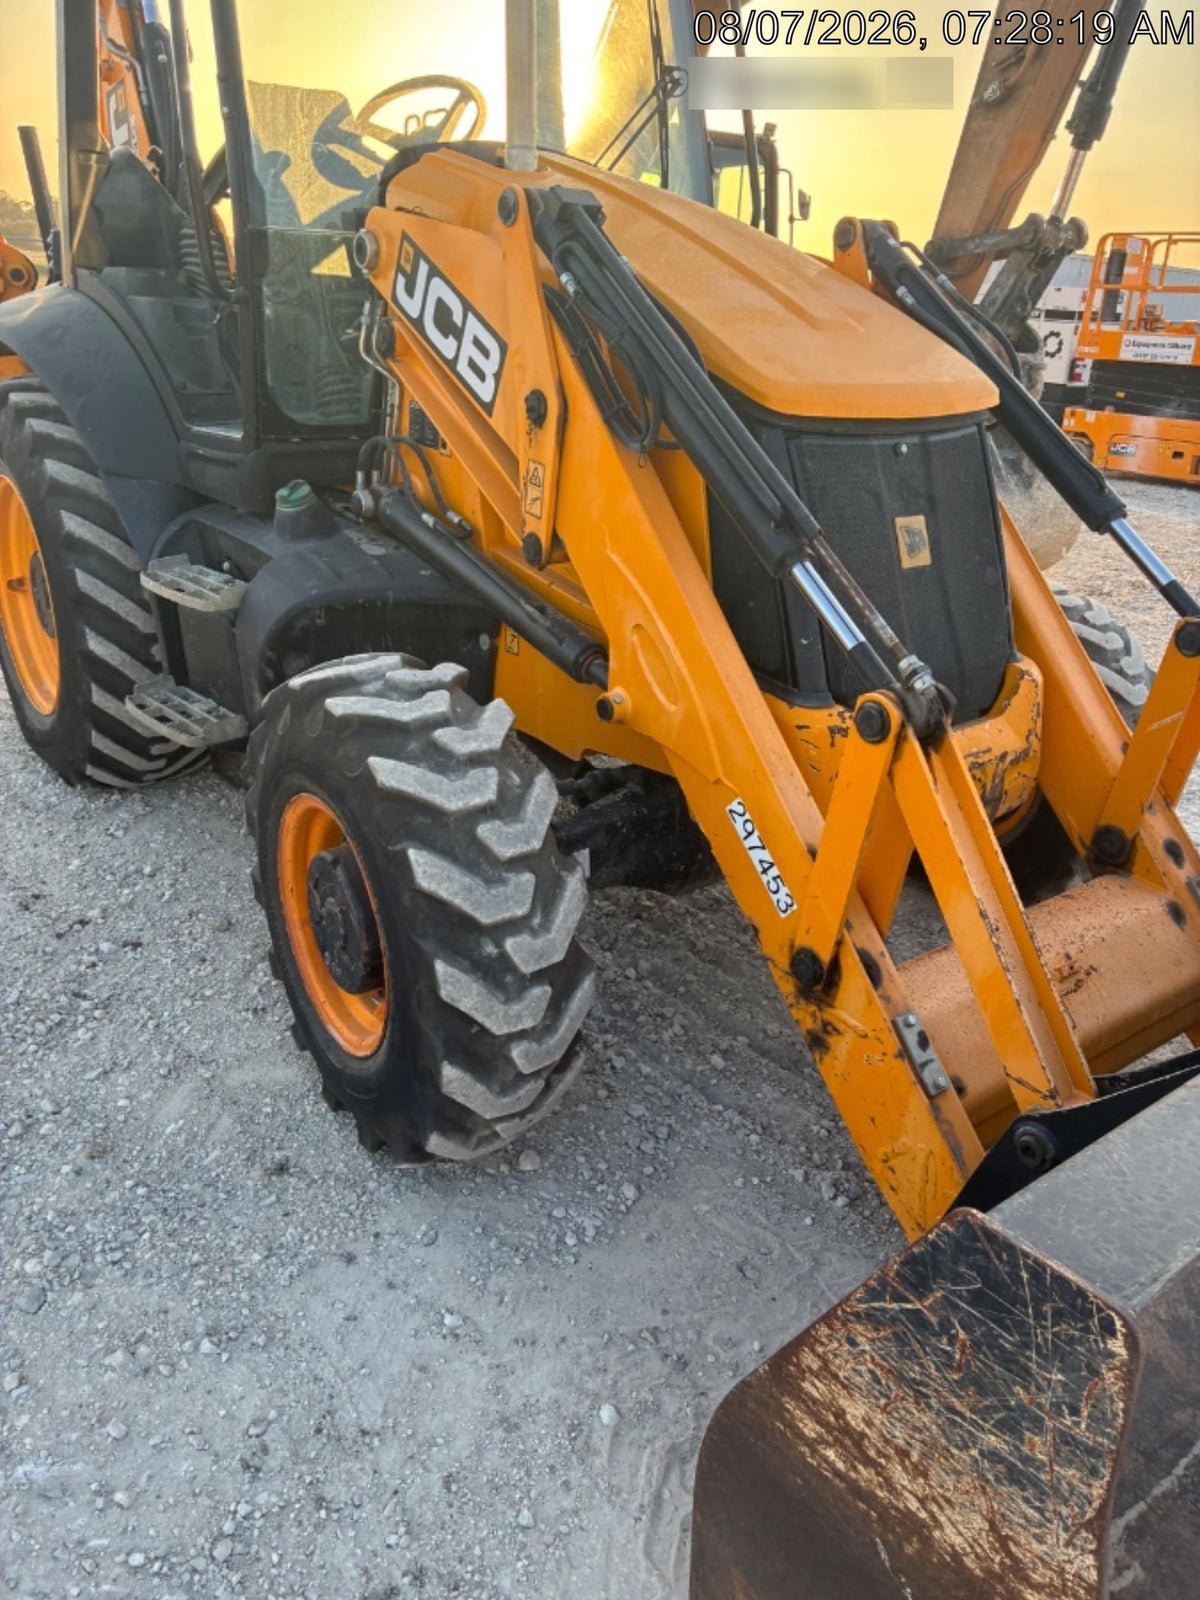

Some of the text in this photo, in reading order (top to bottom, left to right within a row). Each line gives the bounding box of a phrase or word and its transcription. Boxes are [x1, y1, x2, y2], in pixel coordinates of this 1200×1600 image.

[395, 257, 501, 403] JCB
[1110, 443, 1137, 455] JCB
[728, 801, 794, 914] 297453
